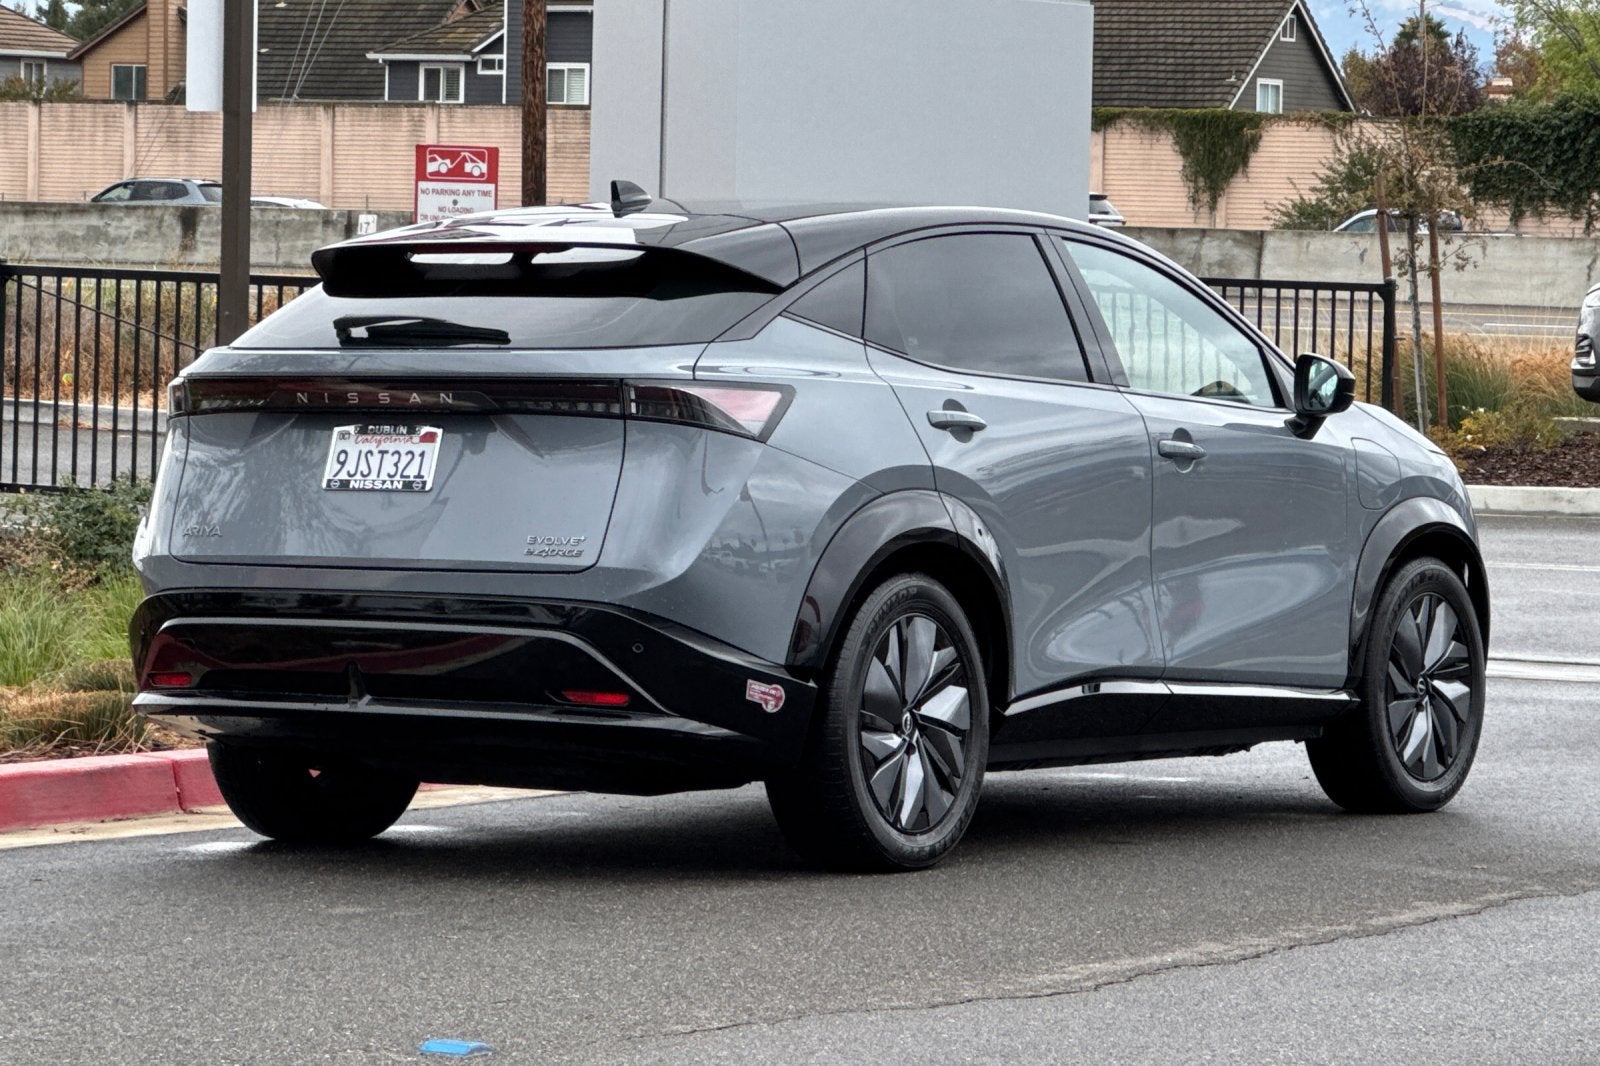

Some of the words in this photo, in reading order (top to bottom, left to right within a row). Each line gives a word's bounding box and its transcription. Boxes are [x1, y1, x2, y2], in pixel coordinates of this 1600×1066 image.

[431, 188, 460, 196] PARKING
[461, 189, 476, 197] ANY
[477, 190, 493, 198] TIME
[447, 206, 474, 214] LOADING
[297, 392, 453, 404] NISSAN
[367, 425, 408, 435] DUBLIN
[354, 434, 415, 448] California
[332, 449, 426, 479] 9JST321
[349, 480, 403, 489] NISSAN
[183, 525, 222, 537] ARIYA
